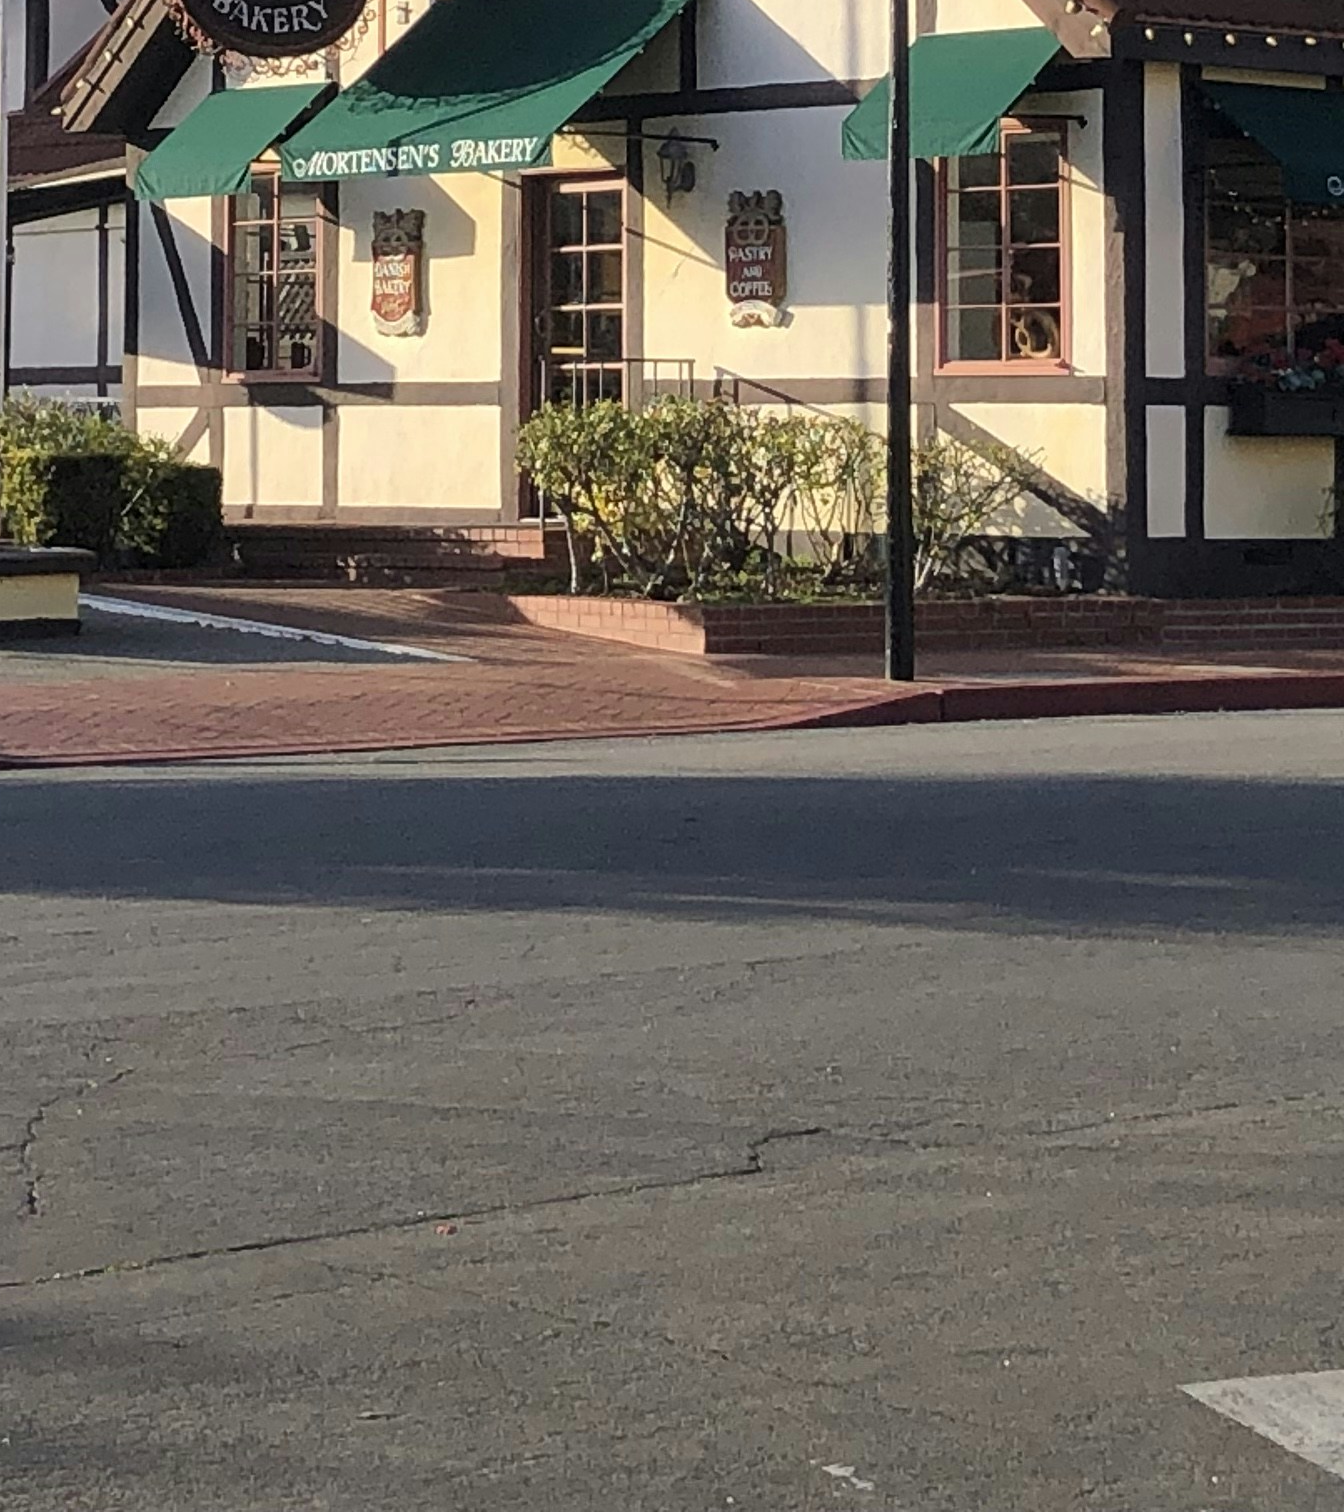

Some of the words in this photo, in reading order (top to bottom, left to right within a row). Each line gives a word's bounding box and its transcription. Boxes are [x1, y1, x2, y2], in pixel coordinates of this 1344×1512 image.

[291, 143, 440, 178] MORTENSEN'S
[449, 136, 539, 168] BAKERY
[728, 246, 773, 263] PASTRY
[730, 281, 773, 298] COFFEE
